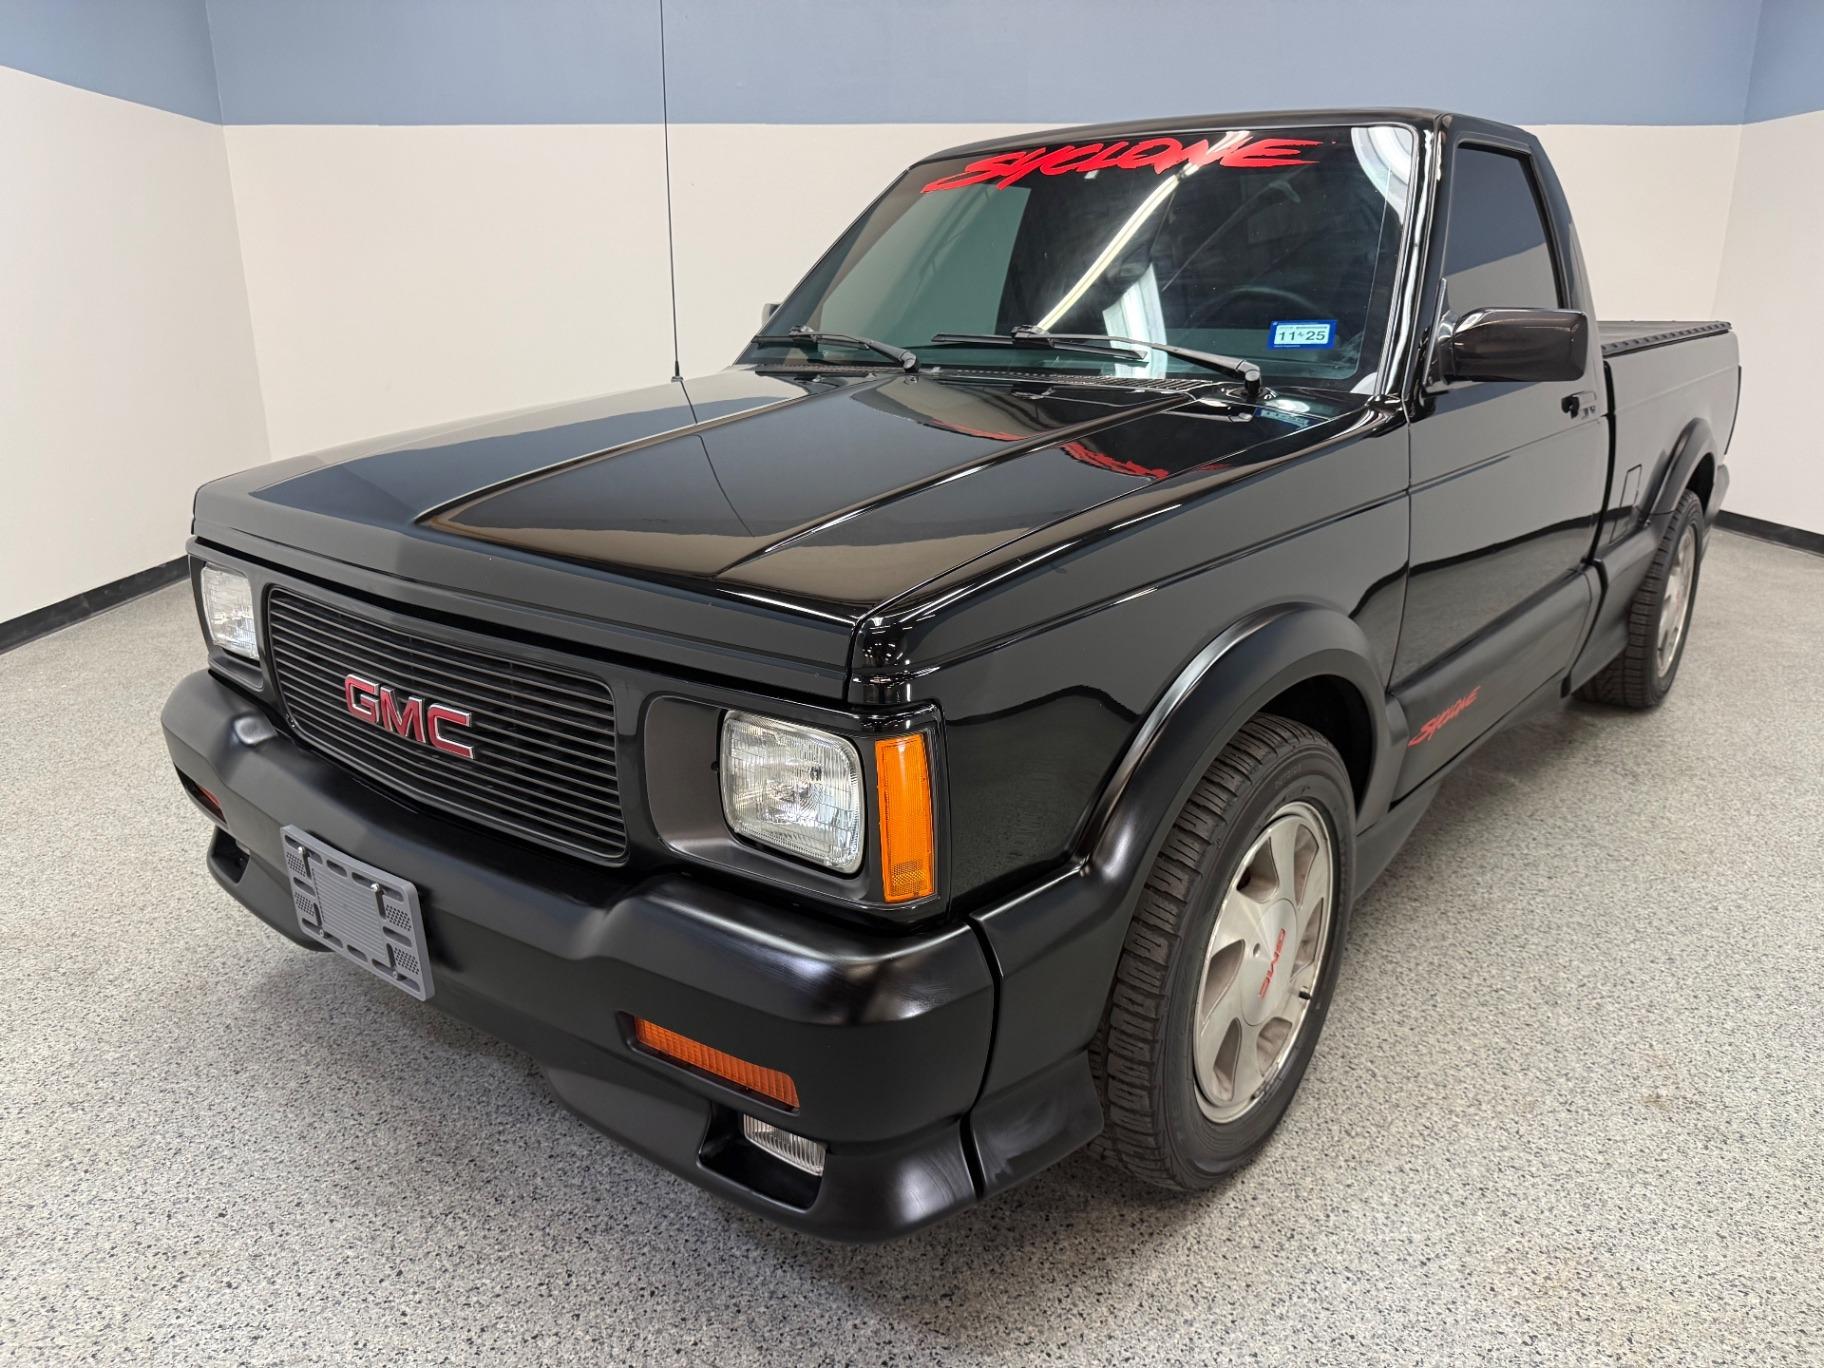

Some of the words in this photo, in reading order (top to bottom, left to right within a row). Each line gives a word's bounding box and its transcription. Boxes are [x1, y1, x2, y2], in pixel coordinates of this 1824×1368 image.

[1279, 331, 1296, 341] 11
[1305, 330, 1327, 341] 25
[344, 674, 475, 759] GMC
[1259, 927, 1287, 999] GMC
